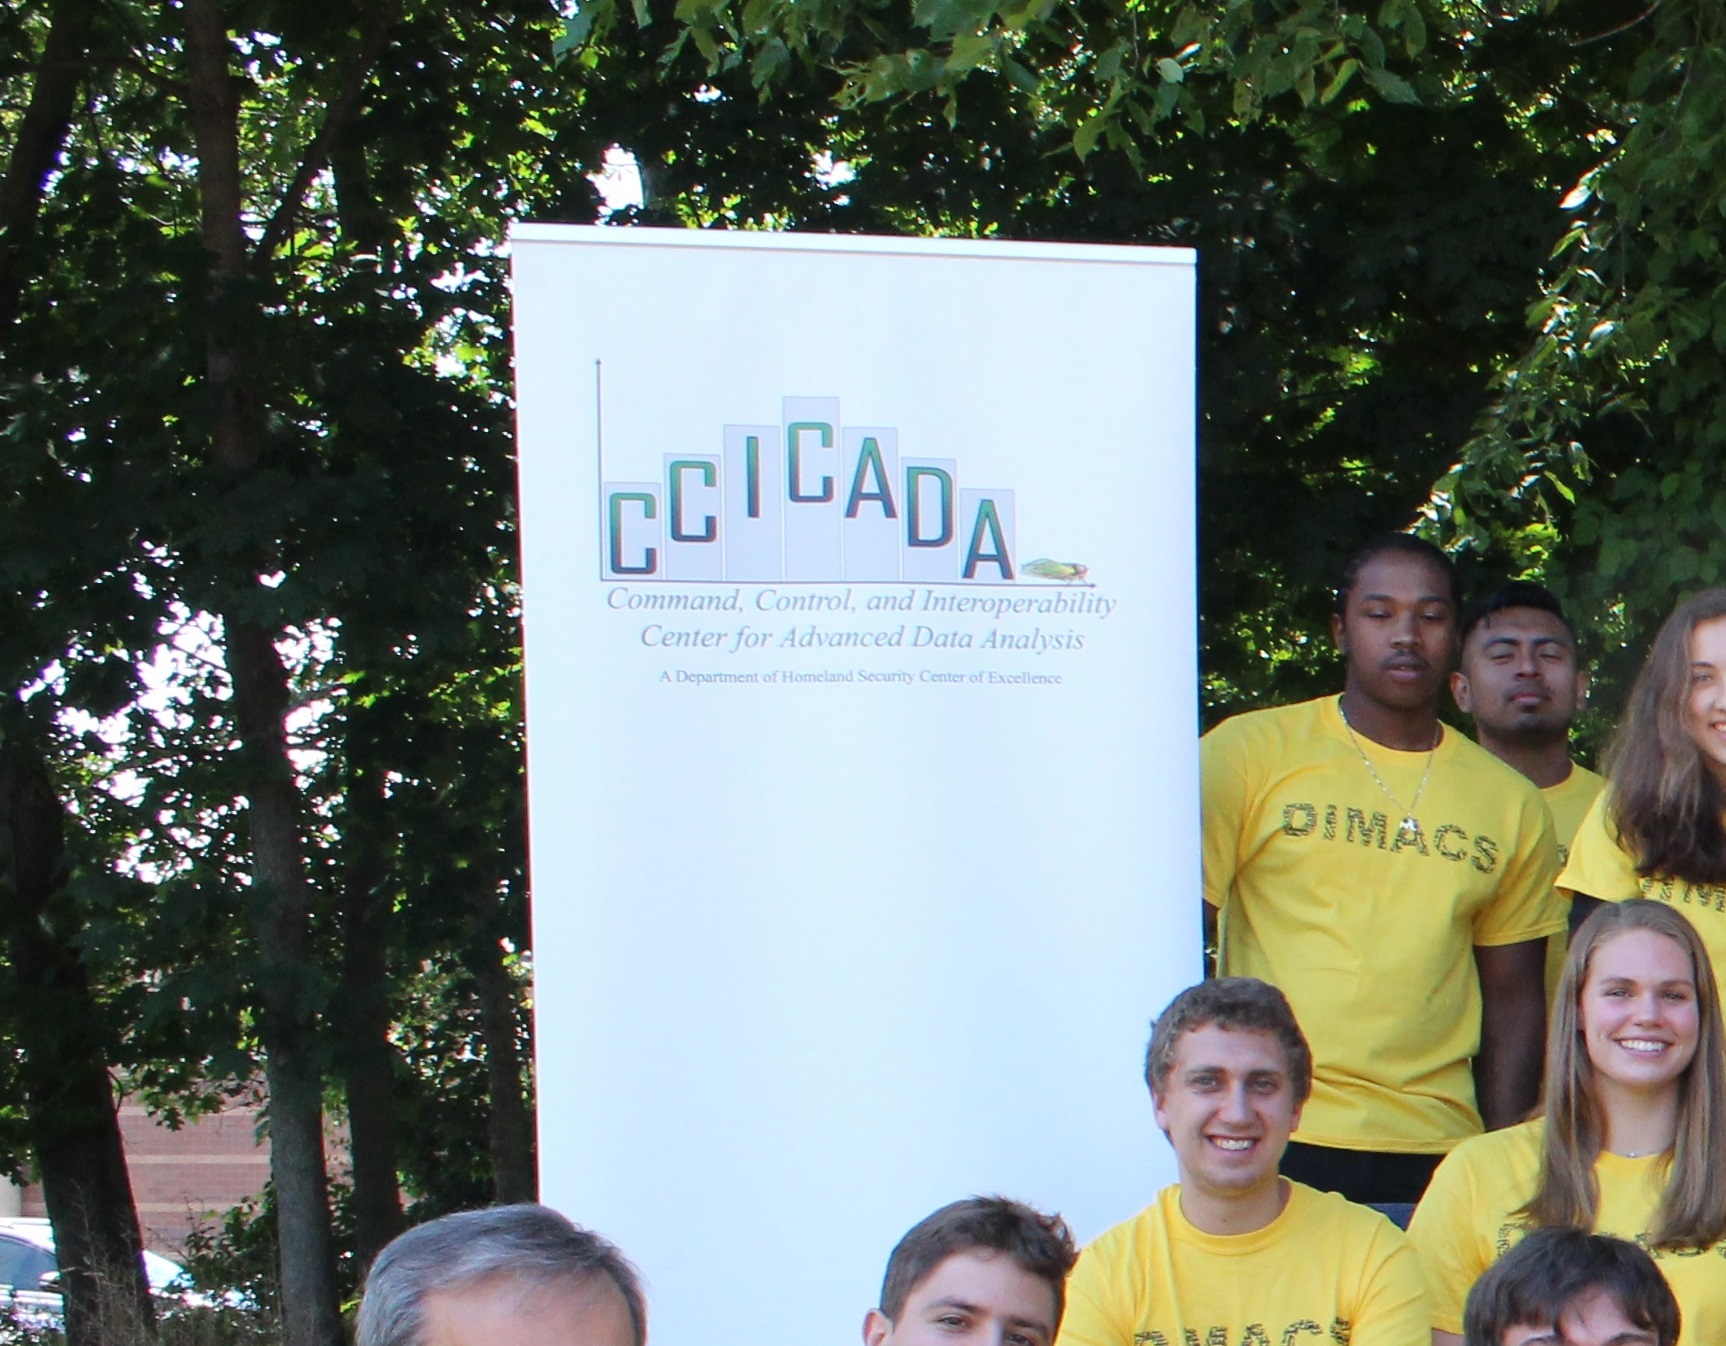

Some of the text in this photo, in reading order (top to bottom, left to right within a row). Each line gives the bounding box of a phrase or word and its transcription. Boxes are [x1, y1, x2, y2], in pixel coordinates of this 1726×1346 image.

[609, 422, 1015, 580] CCICADA
[607, 587, 1116, 619] Command, Control, and Interoperability
[641, 624, 1085, 655] Center for Advanced Data Analysis
[659, 669, 1063, 685] A Department of Homeland Security Center of Excellence
[1283, 802, 1500, 875] DIMACS
